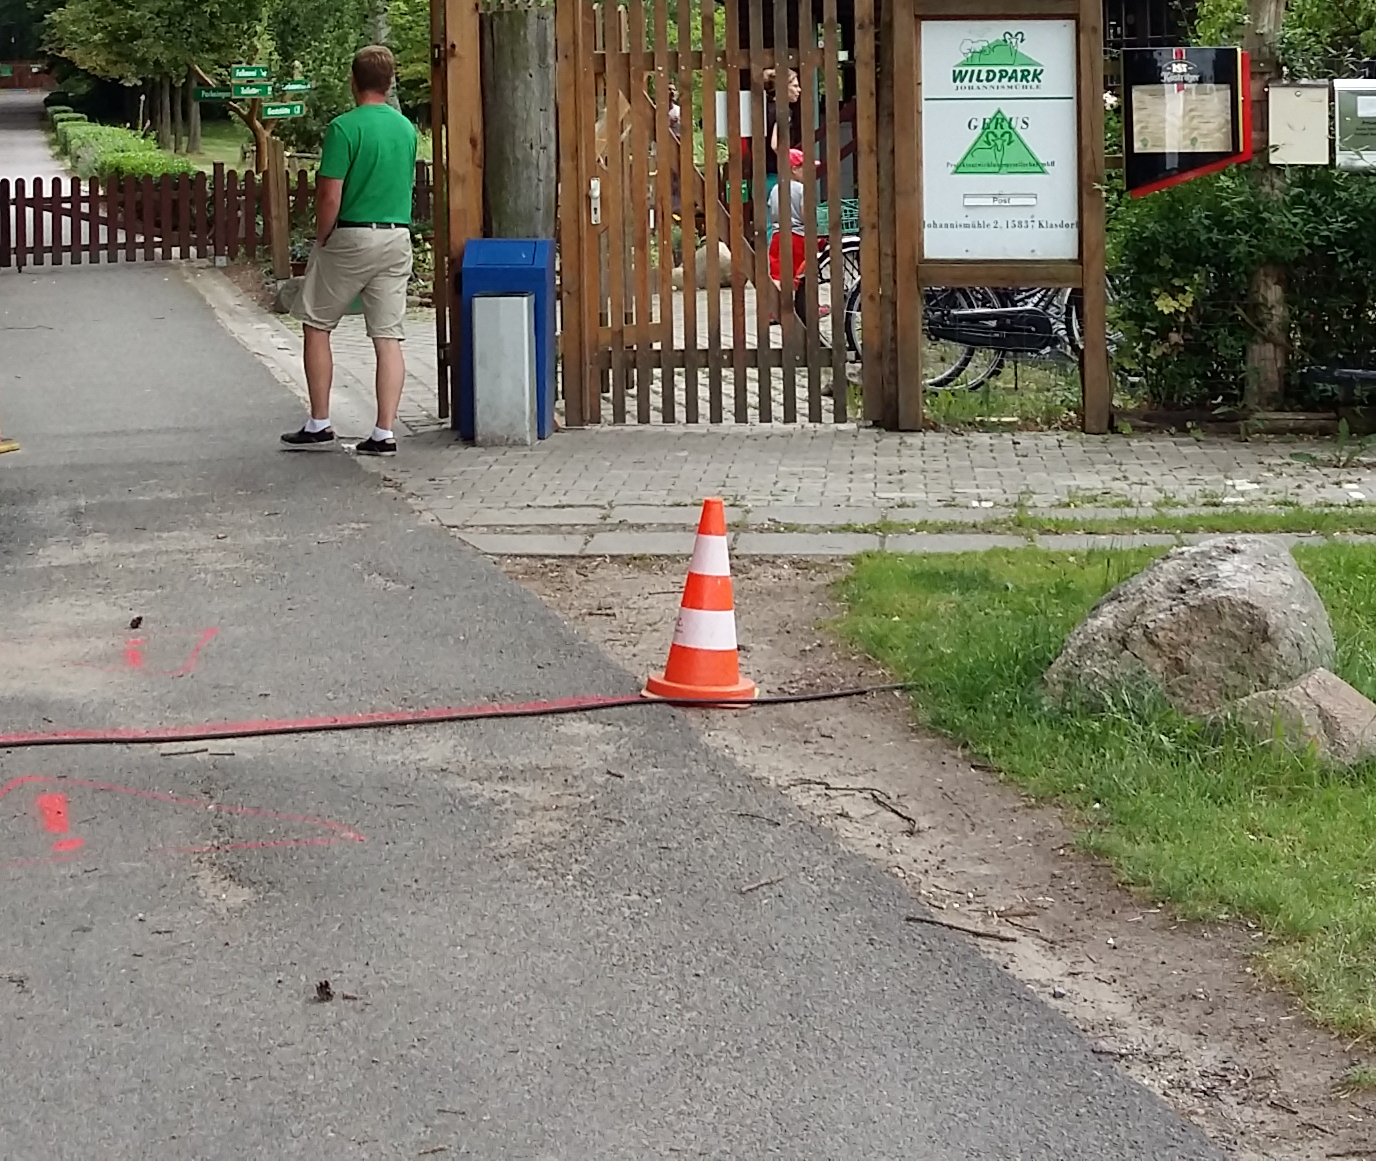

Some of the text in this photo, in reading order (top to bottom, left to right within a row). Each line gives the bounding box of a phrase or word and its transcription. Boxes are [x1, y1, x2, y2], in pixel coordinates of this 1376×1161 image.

[952, 68, 1044, 84] WILDPARK
[967, 116, 1030, 131] GERUS
[992, 196, 1011, 204] Post
[1006, 219, 1035, 229] 15837
